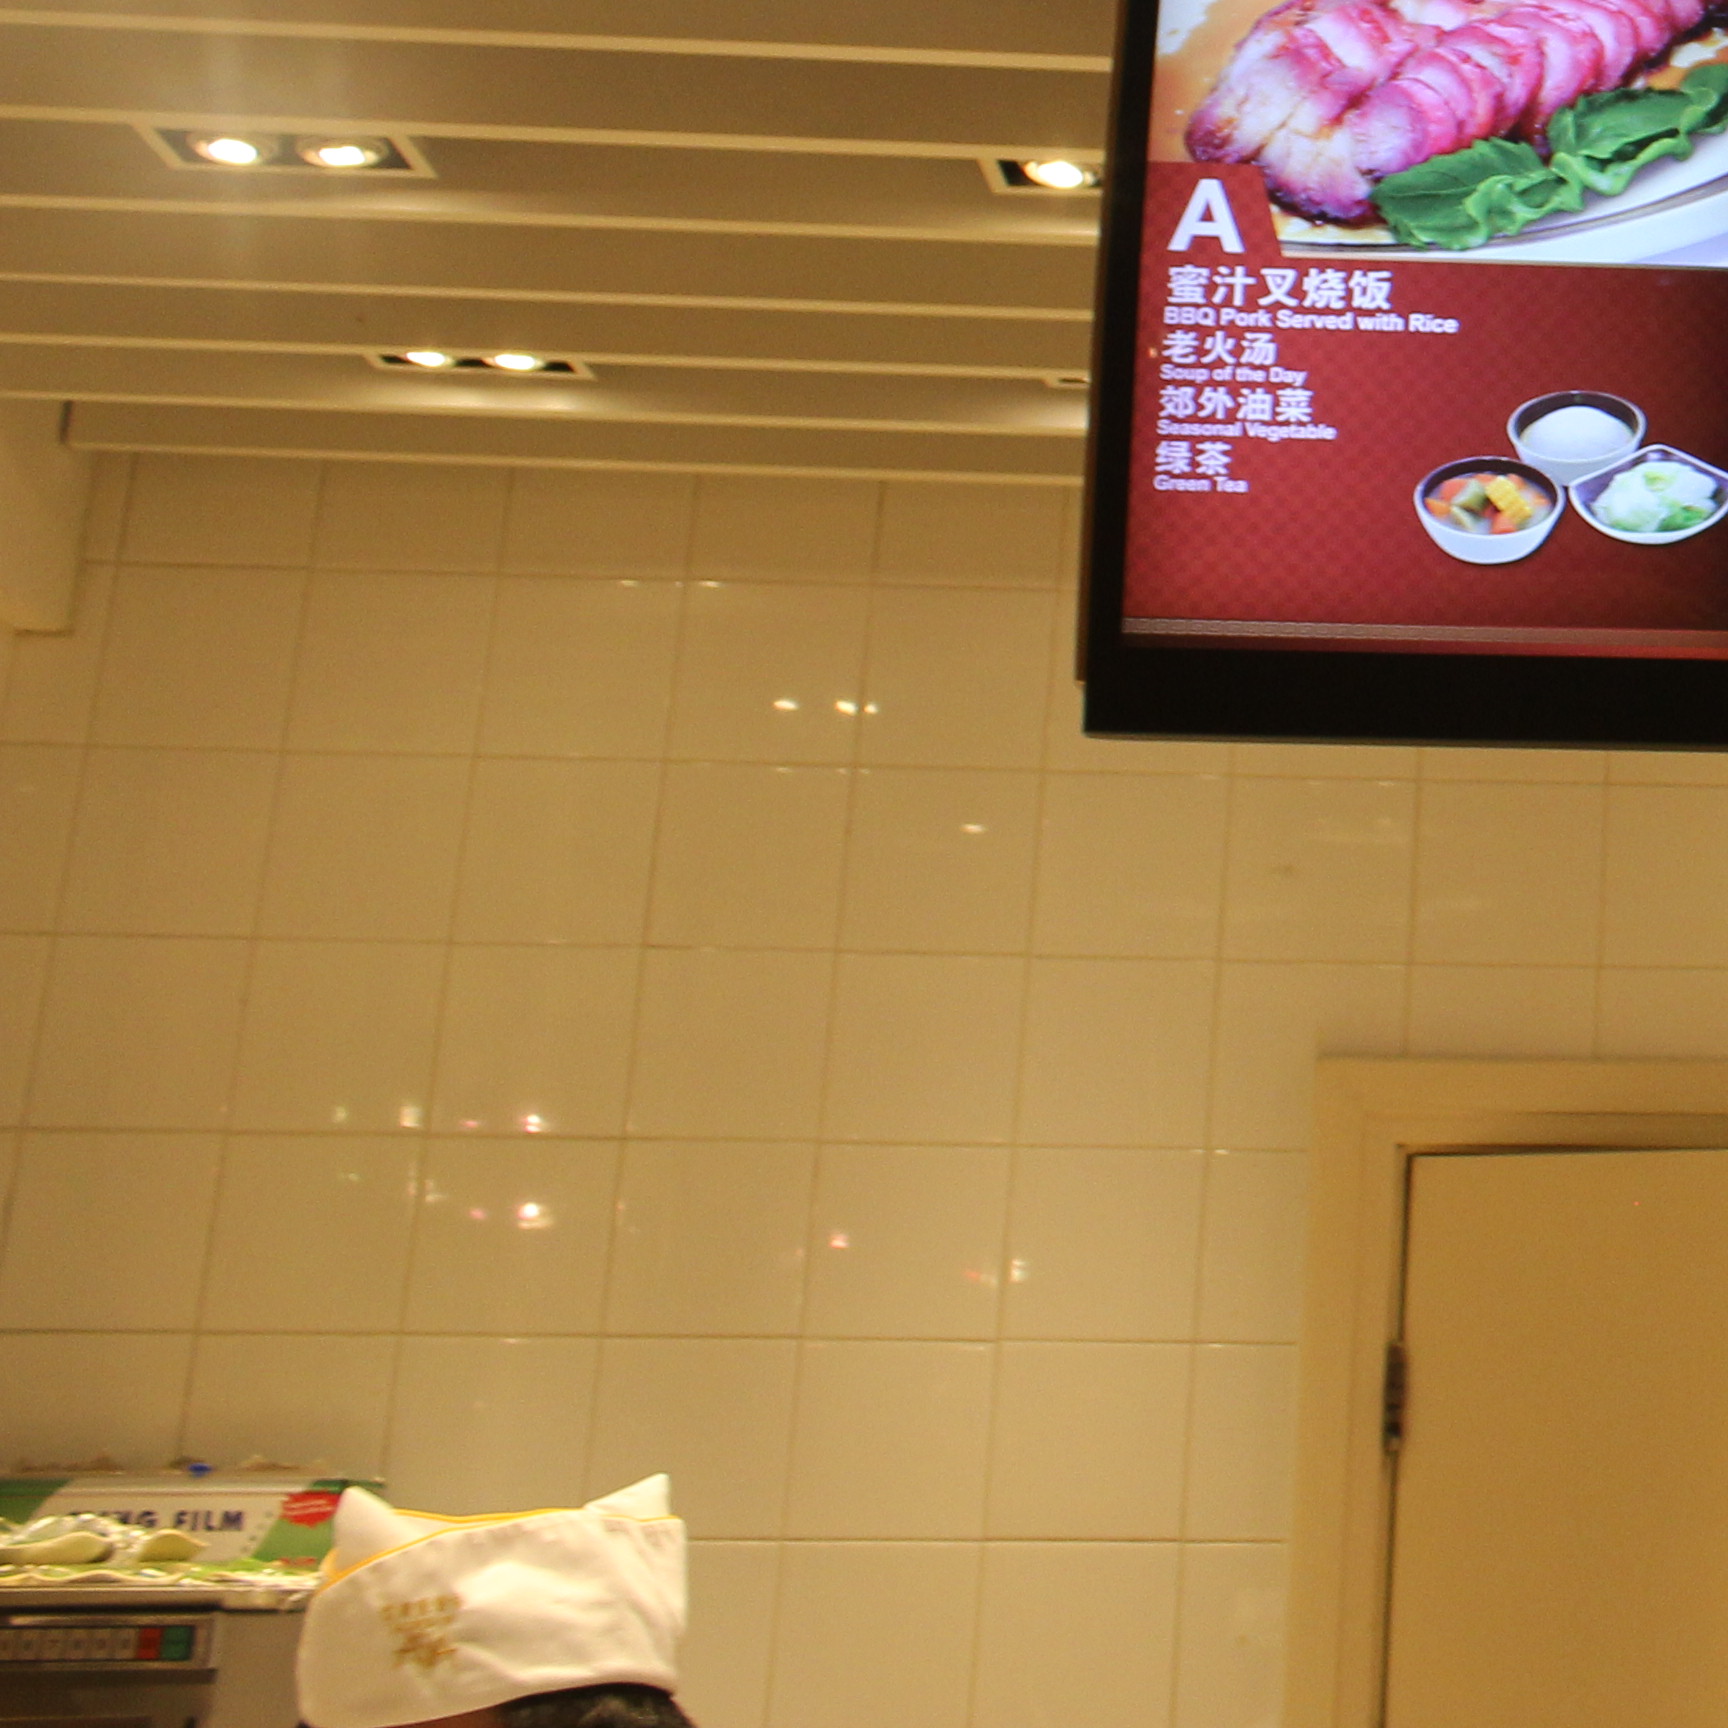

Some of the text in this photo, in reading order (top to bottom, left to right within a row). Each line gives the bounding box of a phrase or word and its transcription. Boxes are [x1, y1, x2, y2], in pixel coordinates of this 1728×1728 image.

[1167, 178, 1245, 254] A
[1167, 263, 1394, 310] 蜜汁叉烧饭
[1163, 305, 1460, 334] BBQ Pork Served with Rice
[1162, 329, 1279, 365] 老火汤
[1159, 364, 1308, 387] Soup of the Day
[1159, 386, 1314, 422] 郊外油菜
[1156, 419, 1338, 442] Seasonal Vegetable
[1155, 440, 1233, 475] 绿茶
[1153, 474, 1249, 494] Green Tea
[174, 1510, 243, 1531] FILM
